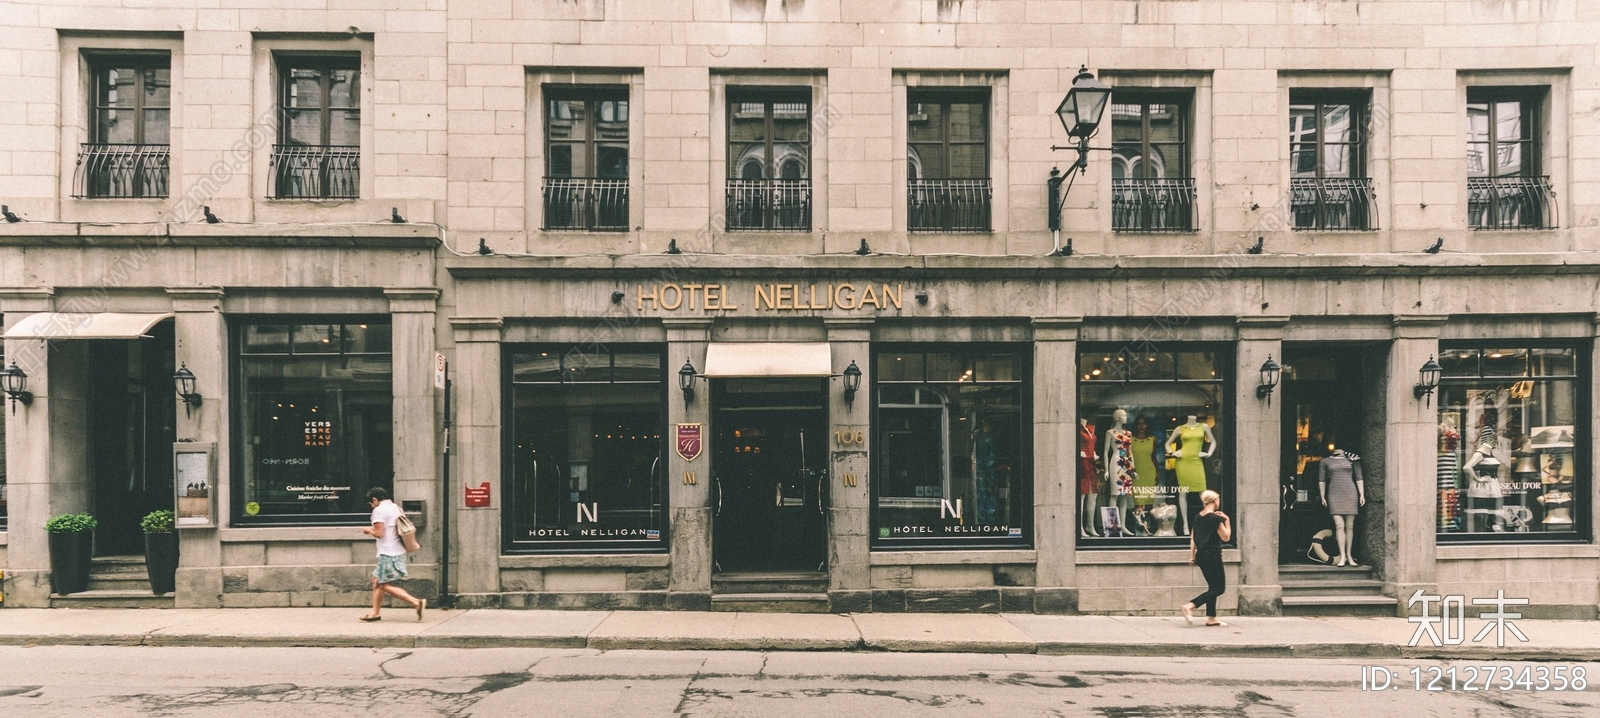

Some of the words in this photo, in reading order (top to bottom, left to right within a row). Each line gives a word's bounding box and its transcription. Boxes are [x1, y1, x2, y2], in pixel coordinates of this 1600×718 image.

[637, 284, 737, 310] HOTEL
[755, 284, 903, 310] NELLIGAN
[834, 430, 864, 444] 106
[683, 471, 696, 485] N
[844, 473, 857, 487] N
[1523, 481, 1541, 489] D'OR
[1171, 485, 1189, 493] D'OR
[577, 502, 598, 523] N
[940, 498, 961, 519] N
[529, 528, 570, 536] HÔTEL
[893, 525, 933, 533] HÔTEL
